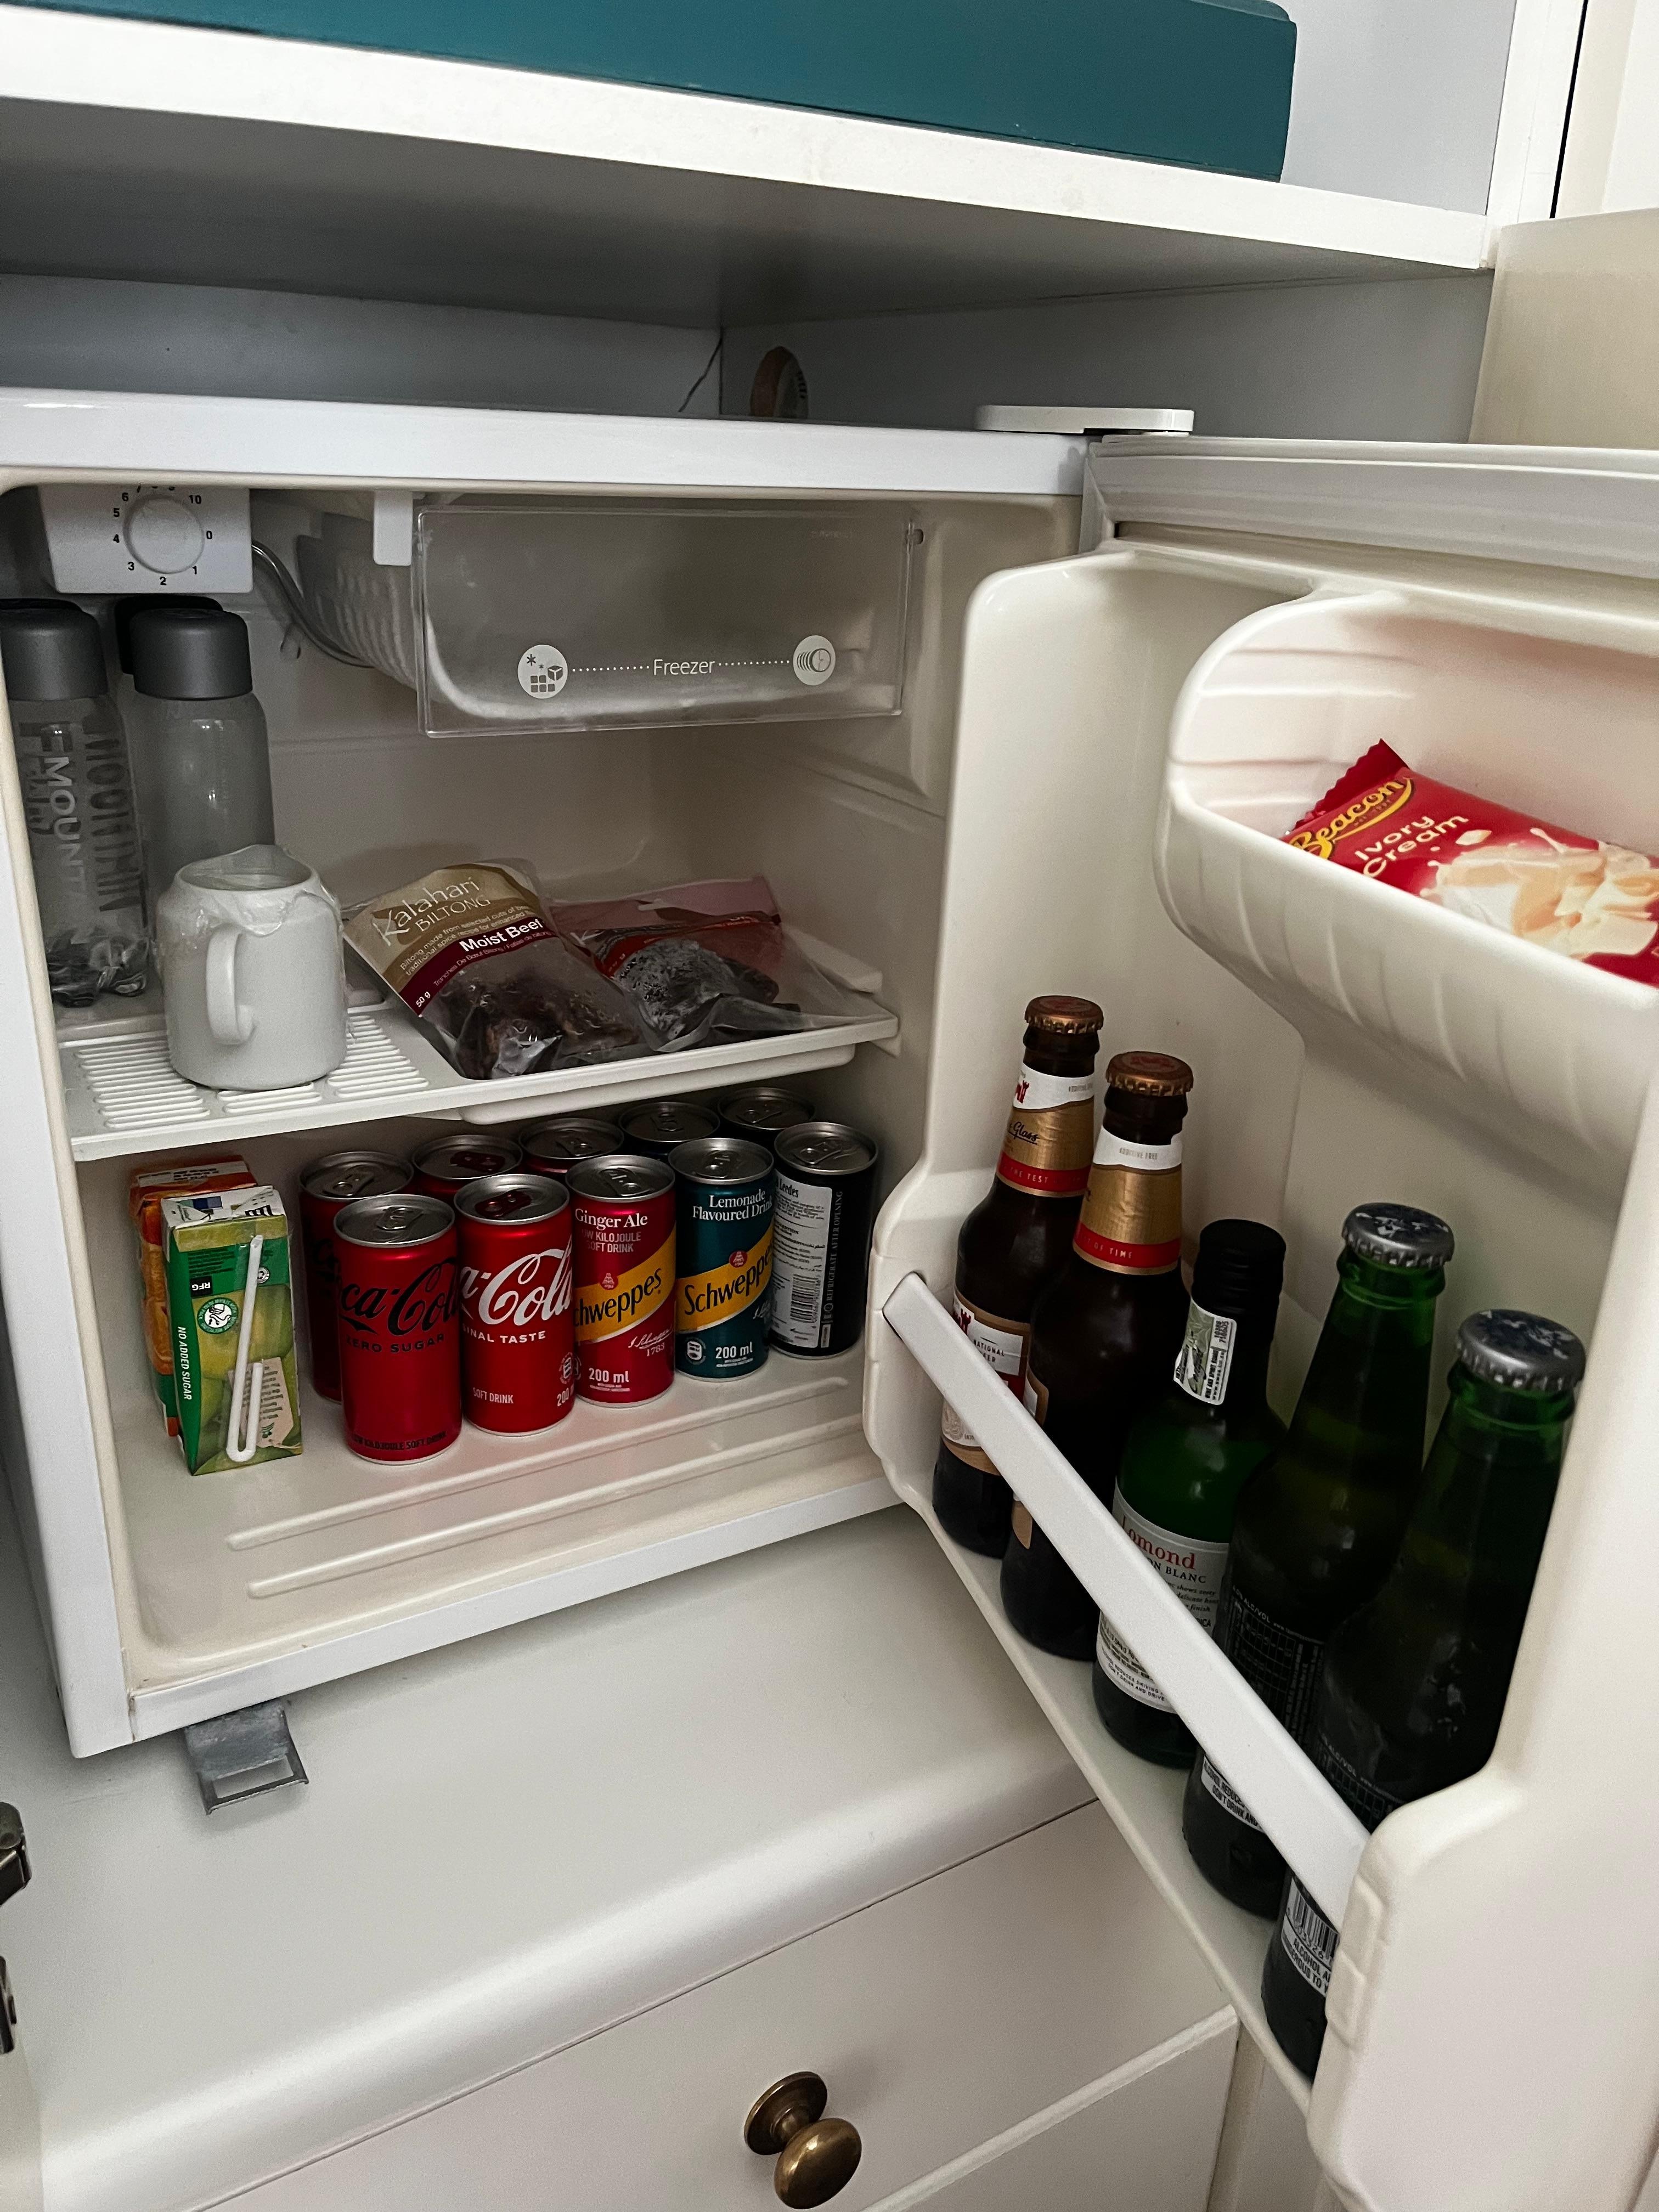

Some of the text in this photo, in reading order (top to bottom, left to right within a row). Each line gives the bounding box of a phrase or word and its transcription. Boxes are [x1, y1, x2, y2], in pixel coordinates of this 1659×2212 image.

[122, 492, 129, 501] 6
[189, 495, 201, 504] 10
[114, 508, 120, 517] 5
[113, 534, 120, 543] 4
[206, 531, 212, 539] 0
[128, 562, 134, 571] 3
[193, 566, 198, 574] 1
[160, 577, 167, 585] 2
[653, 658, 715, 675] Freezer
[1290, 781, 1404, 860] Beacon
[1355, 816, 1435, 861] Ivory
[1363, 816, 1469, 877] Cream
[373, 877, 479, 946] Kalahari
[415, 895, 490, 932] BILTONG
[400, 949, 424, 970] Biltong
[424, 933, 442, 949] made
[443, 925, 460, 935] from
[461, 917, 490, 929] selected
[459, 932, 507, 952] Moist
[406, 947, 437, 976] traditional
[438, 934, 458, 948] spice
[416, 997, 425, 1007] 50
[1014, 1122, 1040, 1142] Glass
[1027, 1174, 1048, 1183] TEST
[709, 1189, 765, 1207] Lemonade
[693, 1206, 749, 1221] Flavoured
[833, 1191, 843, 1225] OPENING
[575, 1208, 648, 1231] Ginger Ale
[587, 1240, 634, 1252] SOFT DRINK
[595, 1232, 641, 1243] KILOJOULE
[1110, 1248, 1132, 1259] TIME
[192, 1282, 211, 1291] RFG
[461, 1234, 573, 1326] a-Cola
[684, 1245, 771, 1316] Schweppe
[573, 1268, 662, 1327] chweppes
[462, 1323, 546, 1344] INAL TASTE
[346, 1333, 444, 1353] ZERO SUGAR
[715, 1341, 753, 1359] 200 ml
[178, 1327, 191, 1400] NO ADDED SUGAR
[589, 1368, 629, 1383] 200 ml
[473, 1387, 514, 1404] SOFT DRINK
[557, 1387, 569, 1406] 200
[1166, 1566, 1206, 1583] BLANC
[1135, 1685, 1146, 1694] AND
[1148, 1691, 1165, 1701] DRIVE
[1137, 1680, 1159, 1694] DRIVING
[1294, 1938, 1321, 1975] ALCOHOL
[1312, 1973, 1322, 1988] TO
